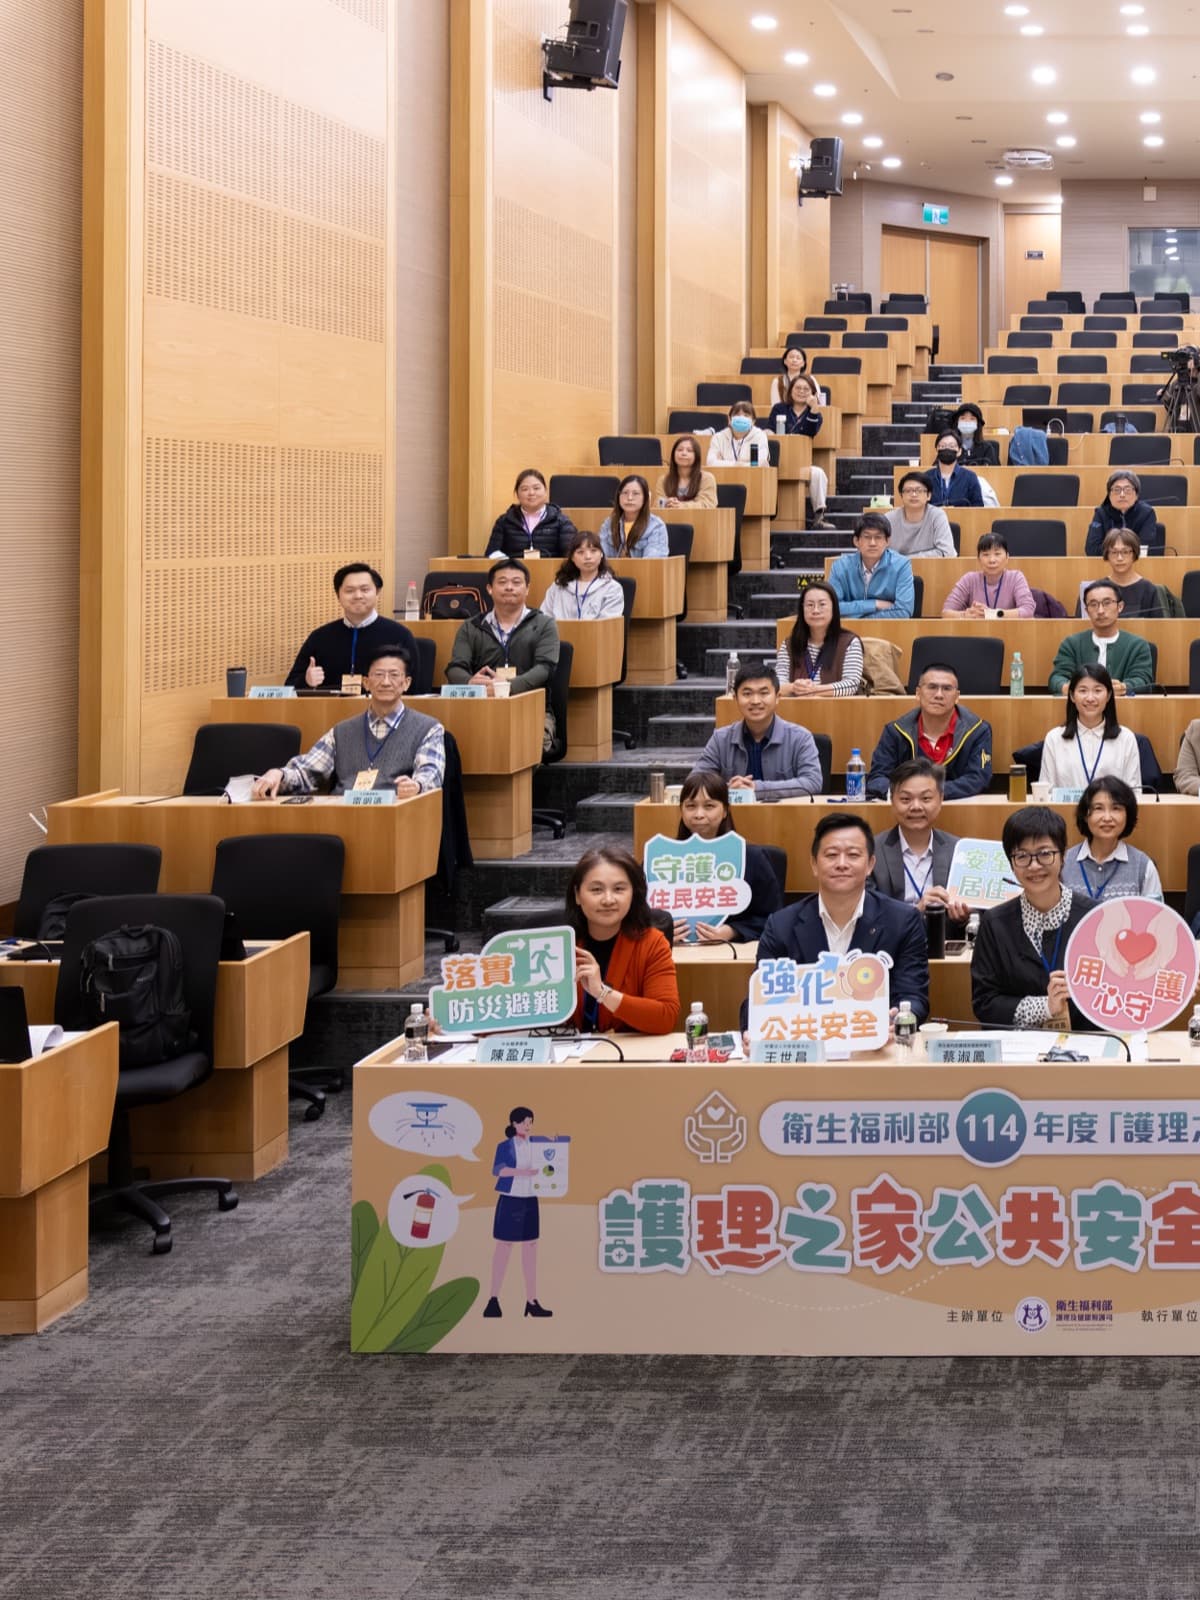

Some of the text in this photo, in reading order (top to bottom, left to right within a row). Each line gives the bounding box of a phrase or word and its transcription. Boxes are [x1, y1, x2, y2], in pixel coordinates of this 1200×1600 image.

[653, 855, 714, 884] 守護
[649, 886, 738, 909] 住民安全
[958, 875, 1006, 900] 居住
[444, 954, 514, 991] 落實
[761, 960, 834, 1006] 強化
[1073, 956, 1184, 1022] 用心守護
[448, 989, 559, 1025] 防災避難
[760, 1009, 878, 1040] 公共安全
[490, 1048, 535, 1062] 陳盈月
[942, 1050, 986, 1063] 蔡淑鳳
[946, 1309, 1004, 1323] 主辦單位
[1056, 1299, 1113, 1312] 衛生福利部
[1141, 1308, 1199, 1323] 執行單位
